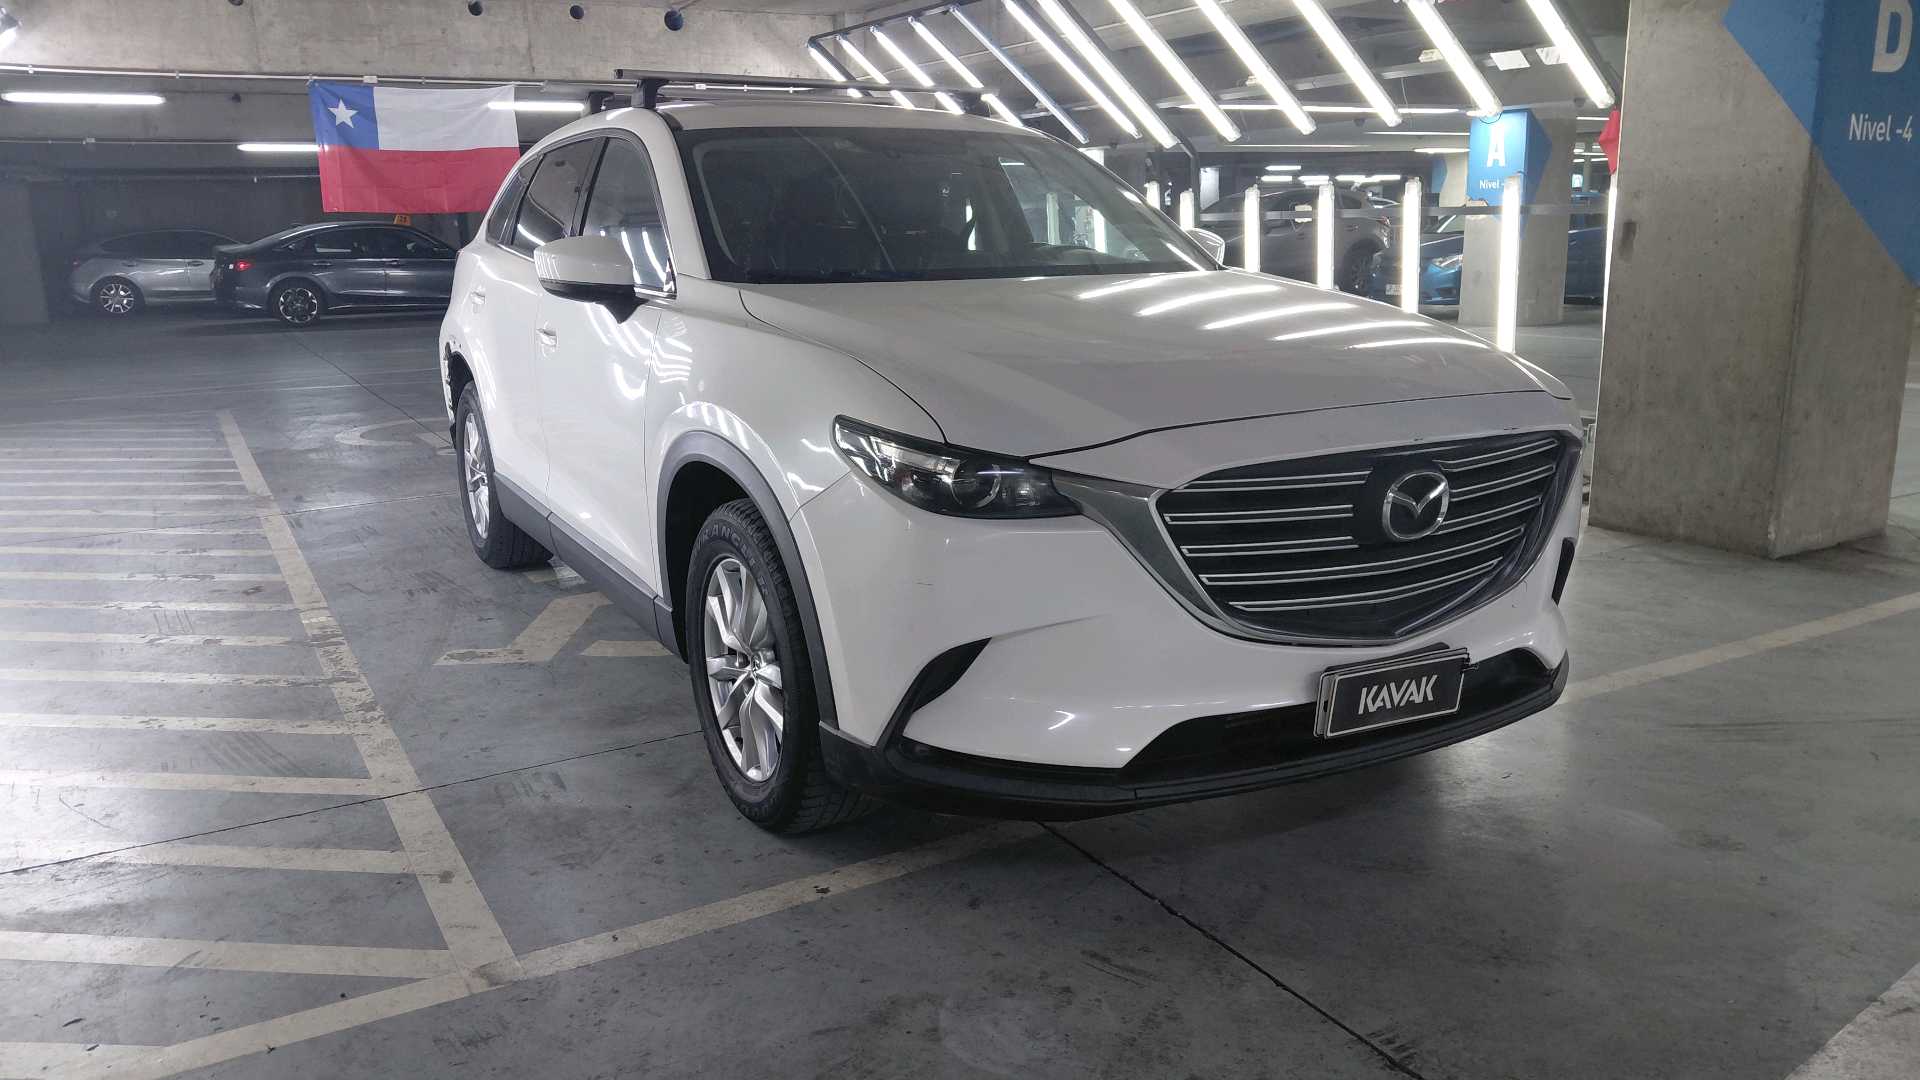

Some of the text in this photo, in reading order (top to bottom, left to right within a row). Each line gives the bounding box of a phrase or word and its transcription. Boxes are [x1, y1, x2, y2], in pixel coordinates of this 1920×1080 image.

[1872, 0, 1913, 73] D
[1487, 122, 1506, 167] A
[1848, 113, 1913, 142] Nivel -4
[1479, 179, 1500, 190] Nivel
[1358, 674, 1438, 715] KAVAK
